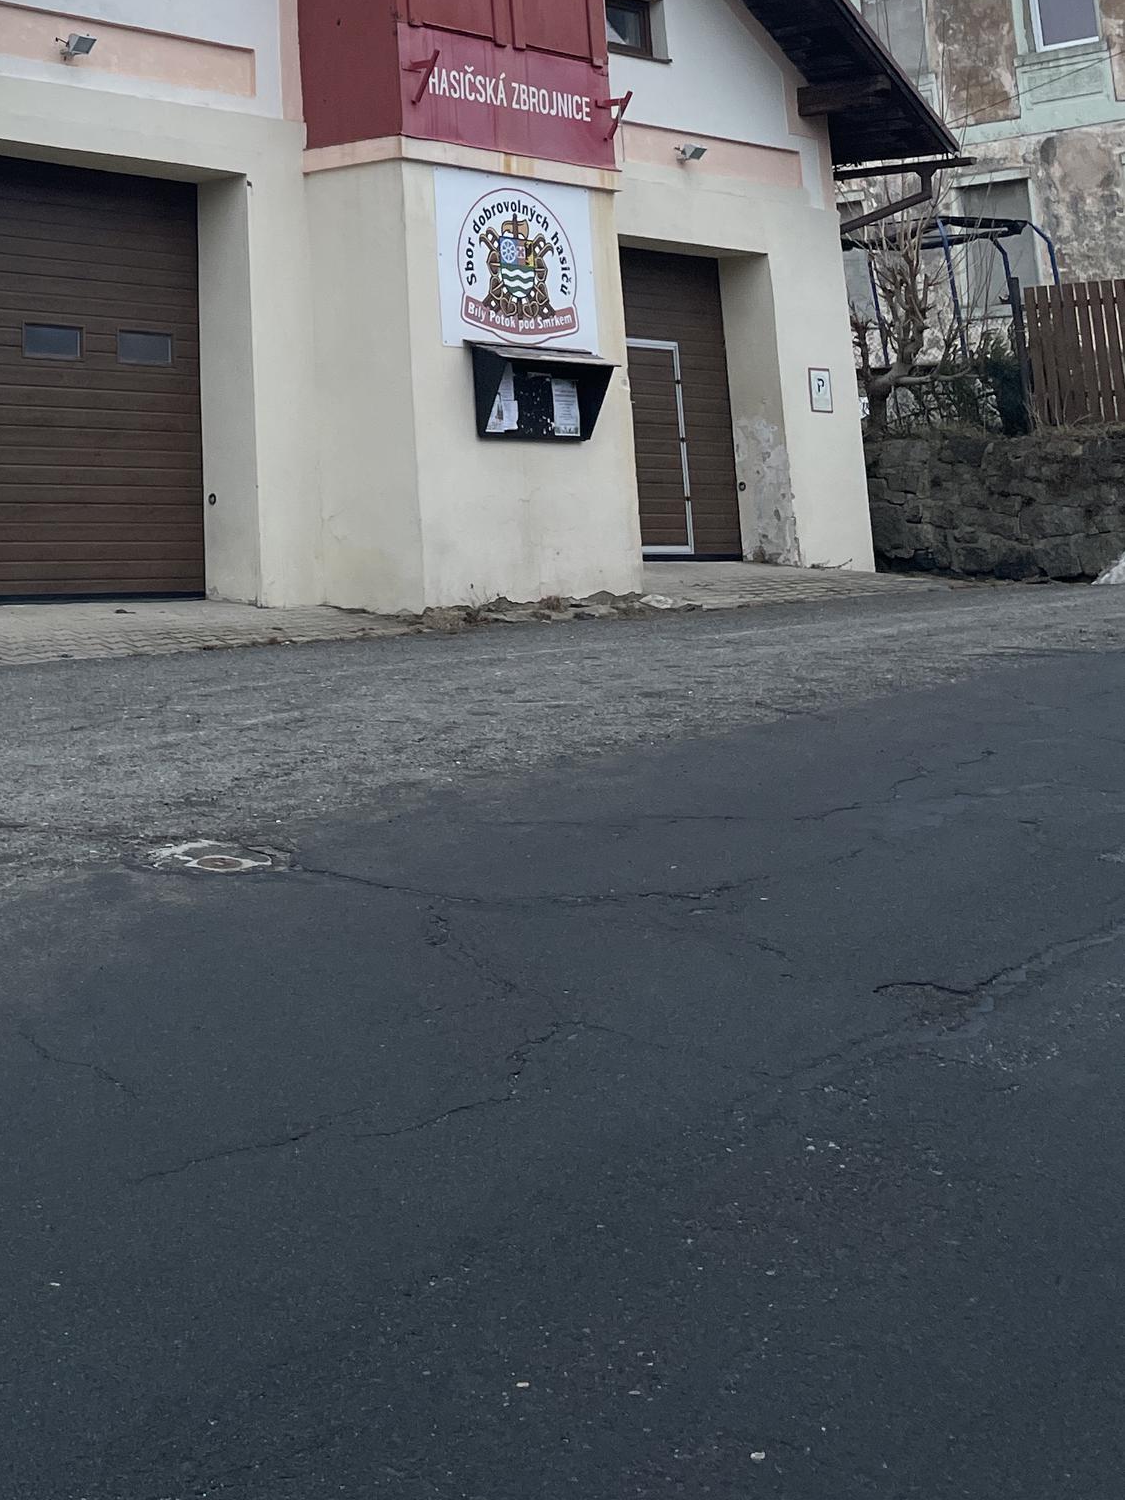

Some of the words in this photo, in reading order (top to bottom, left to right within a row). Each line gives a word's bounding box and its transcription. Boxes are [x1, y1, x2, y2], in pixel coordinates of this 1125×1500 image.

[428, 64, 507, 107] HASIČSKÁ
[511, 82, 591, 122] ZBROJNICE
[465, 237, 477, 286] Sbor
[473, 200, 549, 234] dobrovolných
[551, 231, 572, 296] hasičů
[489, 310, 516, 328] Potok
[518, 317, 535, 332] pod
[537, 314, 572, 329] Smrkem
